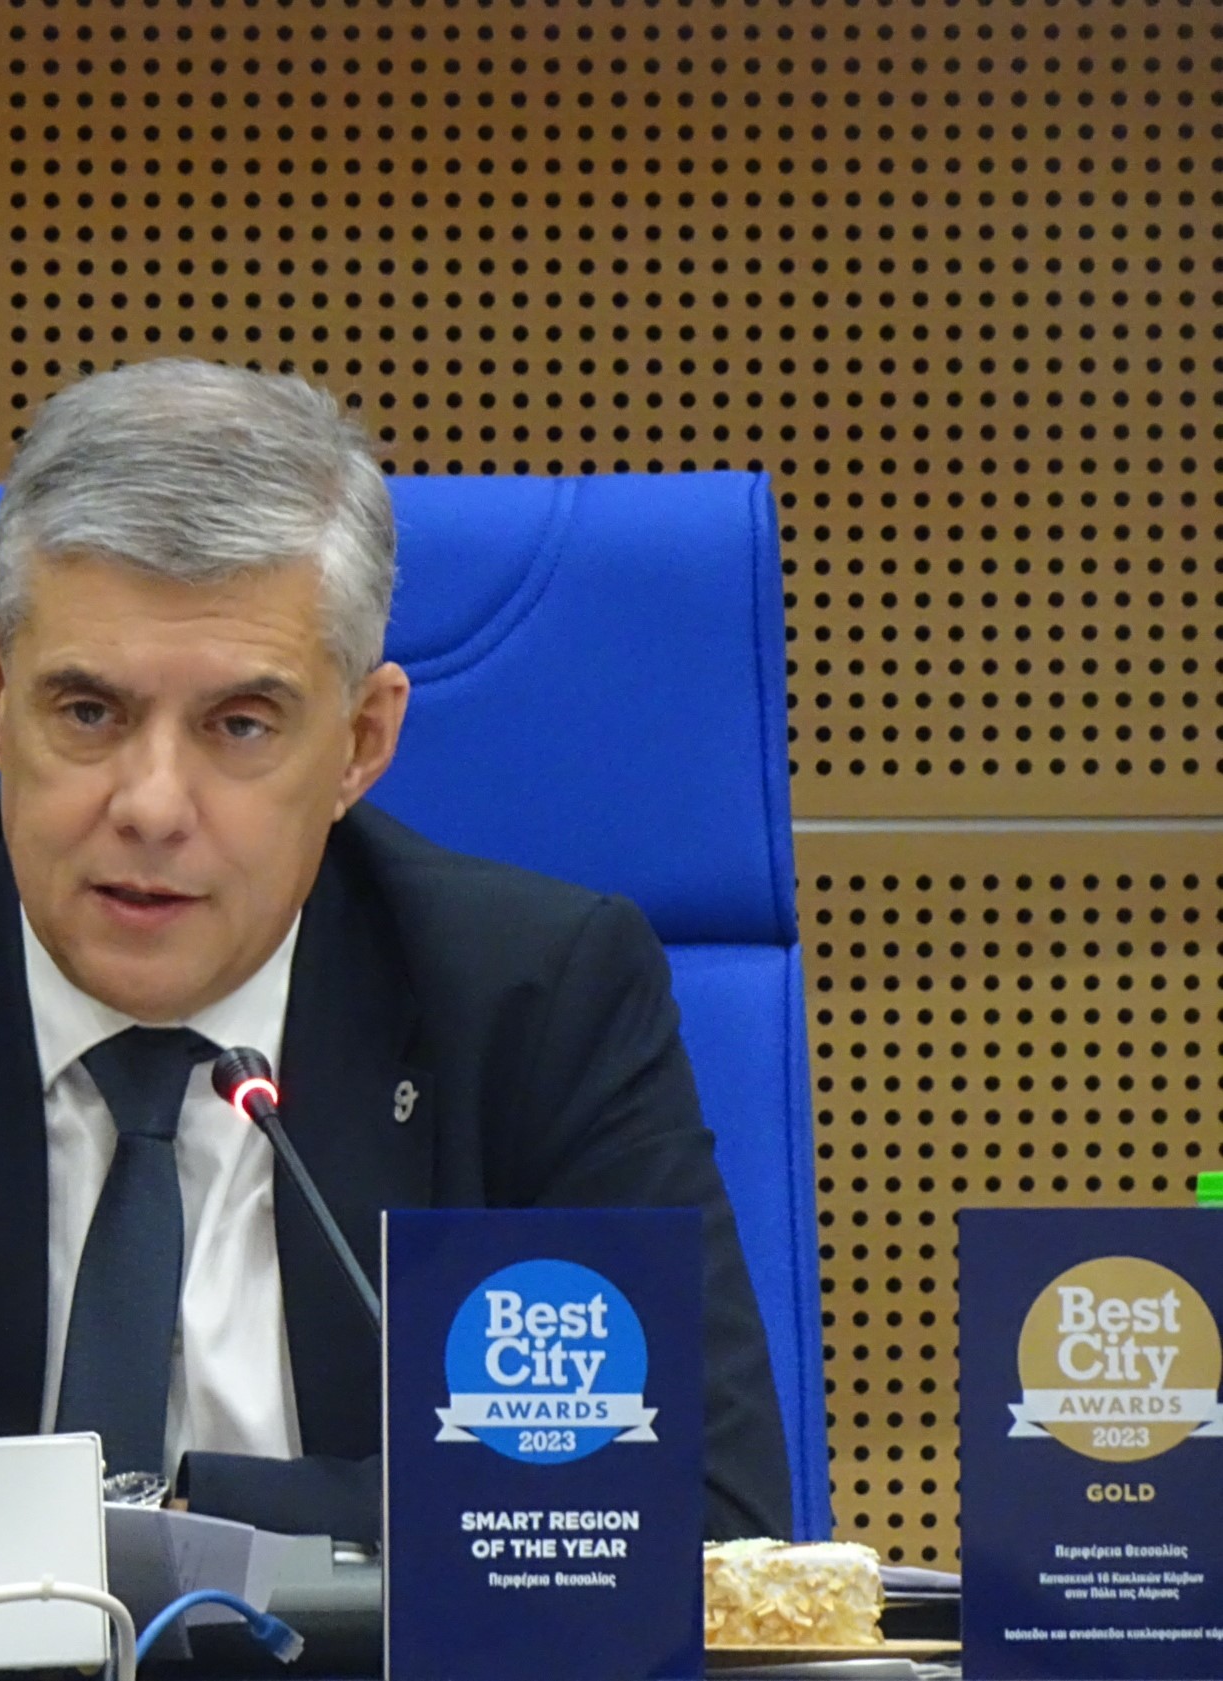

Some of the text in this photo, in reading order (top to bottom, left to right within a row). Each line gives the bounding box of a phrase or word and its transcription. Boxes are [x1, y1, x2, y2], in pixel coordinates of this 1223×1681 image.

[485, 1290, 608, 1339] Best
[1057, 1286, 1181, 1333] Best
[485, 1337, 606, 1393] City
[1057, 1333, 1180, 1389] City
[486, 1400, 609, 1420] AWARDS
[1059, 1396, 1183, 1415] AWARDS
[518, 1430, 576, 1453] 2023
[1092, 1427, 1151, 1448] 2023
[1086, 1484, 1156, 1502] GOLD
[461, 1511, 640, 1531] SMART REGION
[471, 1539, 627, 1559] OF THE YEAR
[1054, 1544, 1189, 1560] Περιφέρεια Θεσσαλίας
[488, 1571, 617, 1588] Περιφέρεια Θεσσαλίας
[1050, 1629, 1067, 1640] και
